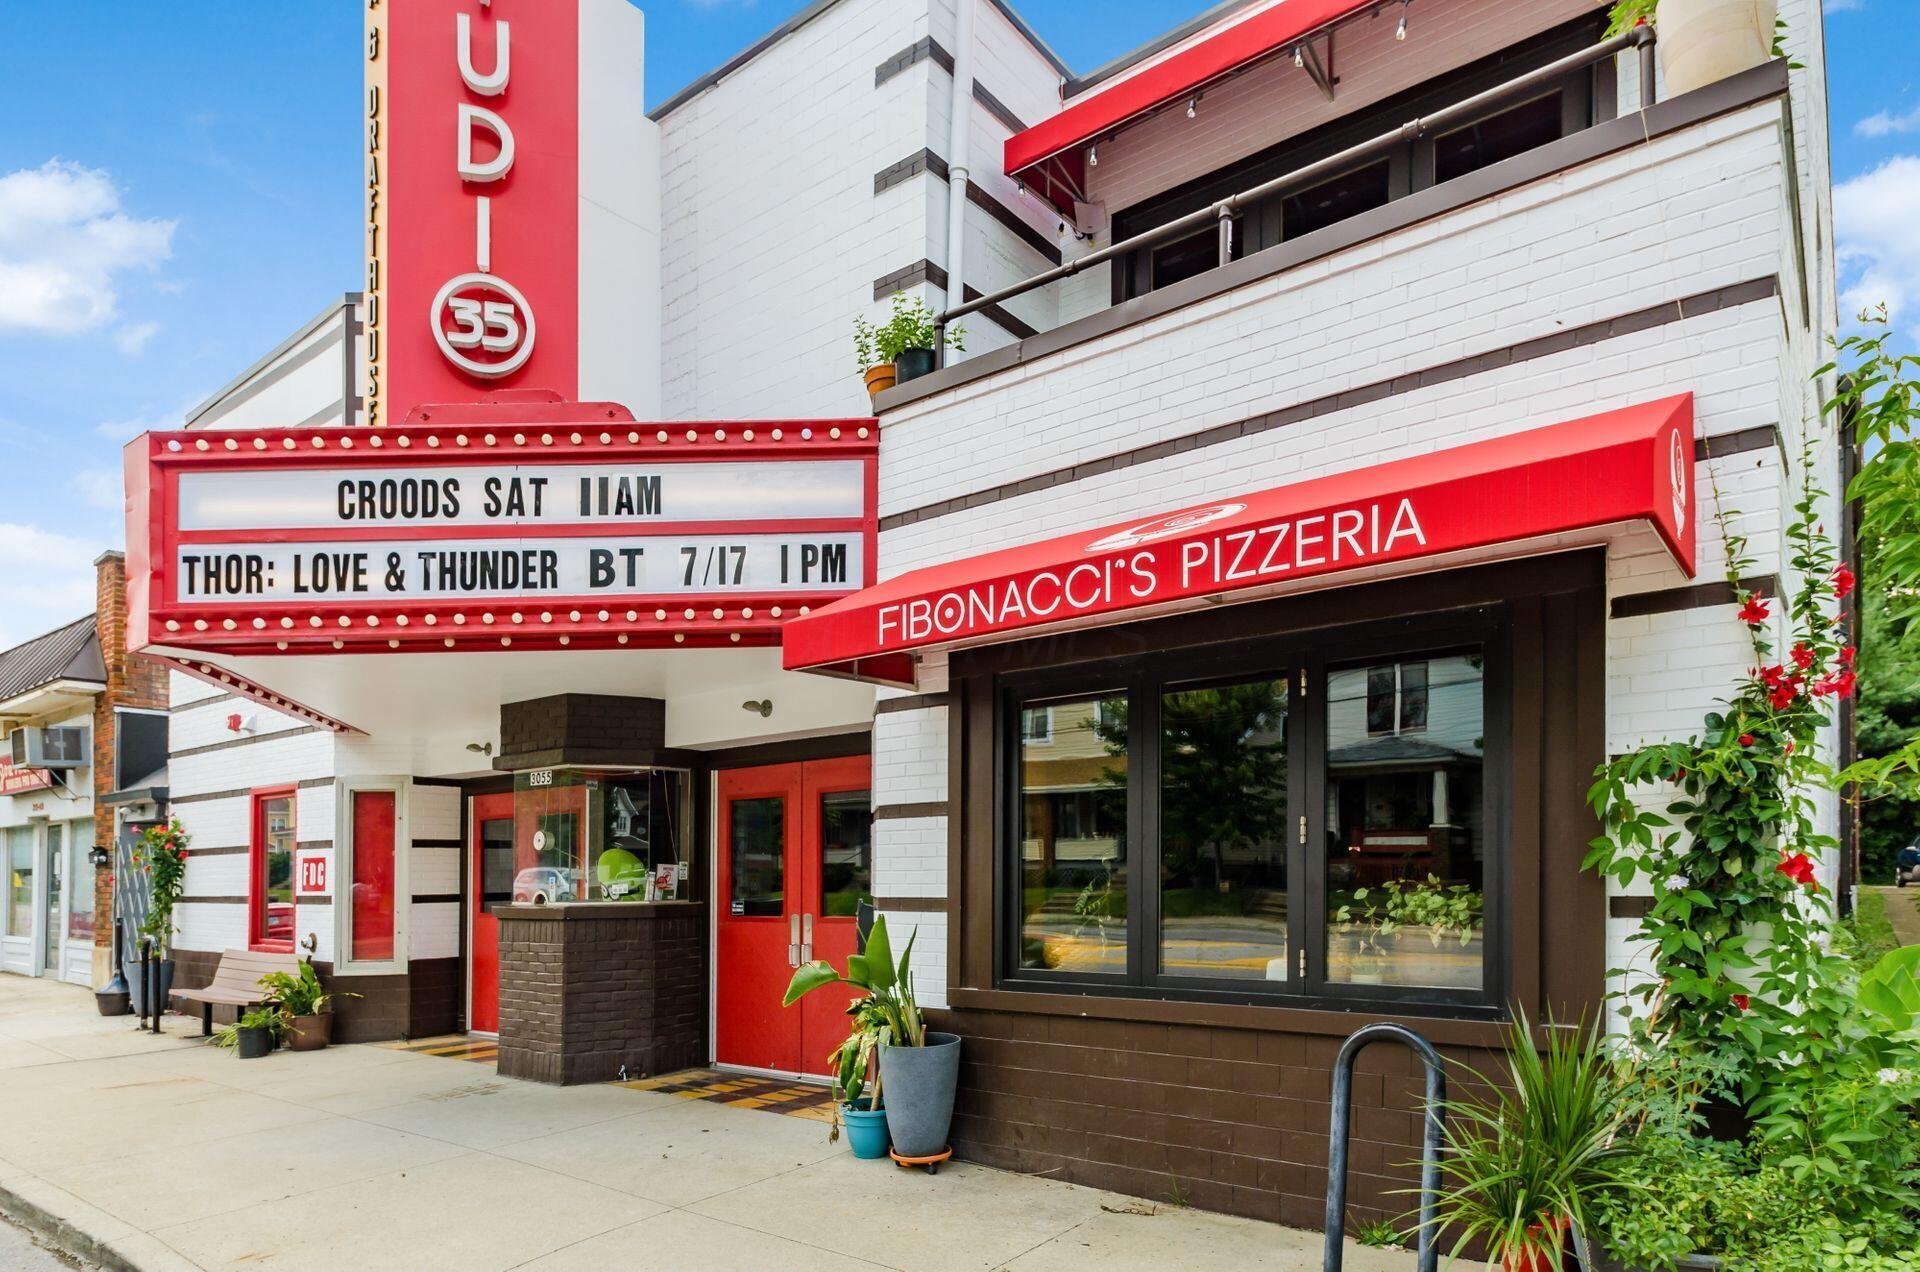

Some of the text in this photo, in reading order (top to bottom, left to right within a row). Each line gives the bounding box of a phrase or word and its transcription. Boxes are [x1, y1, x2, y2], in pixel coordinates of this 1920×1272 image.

[447, 297, 519, 352] 35
[338, 479, 460, 519] CROODS
[484, 477, 548, 517] SAT
[182, 555, 274, 594] THOR:
[294, 553, 368, 592] LOVE
[385, 552, 405, 591] &
[418, 550, 558, 590] THUNDER
[590, 548, 644, 587] BT
[681, 547, 746, 585] 7/17
[879, 499, 1427, 645] FIBONACCI'S PIZZERIA
[530, 772, 552, 785] 3055
[303, 861, 325, 887] FDC
